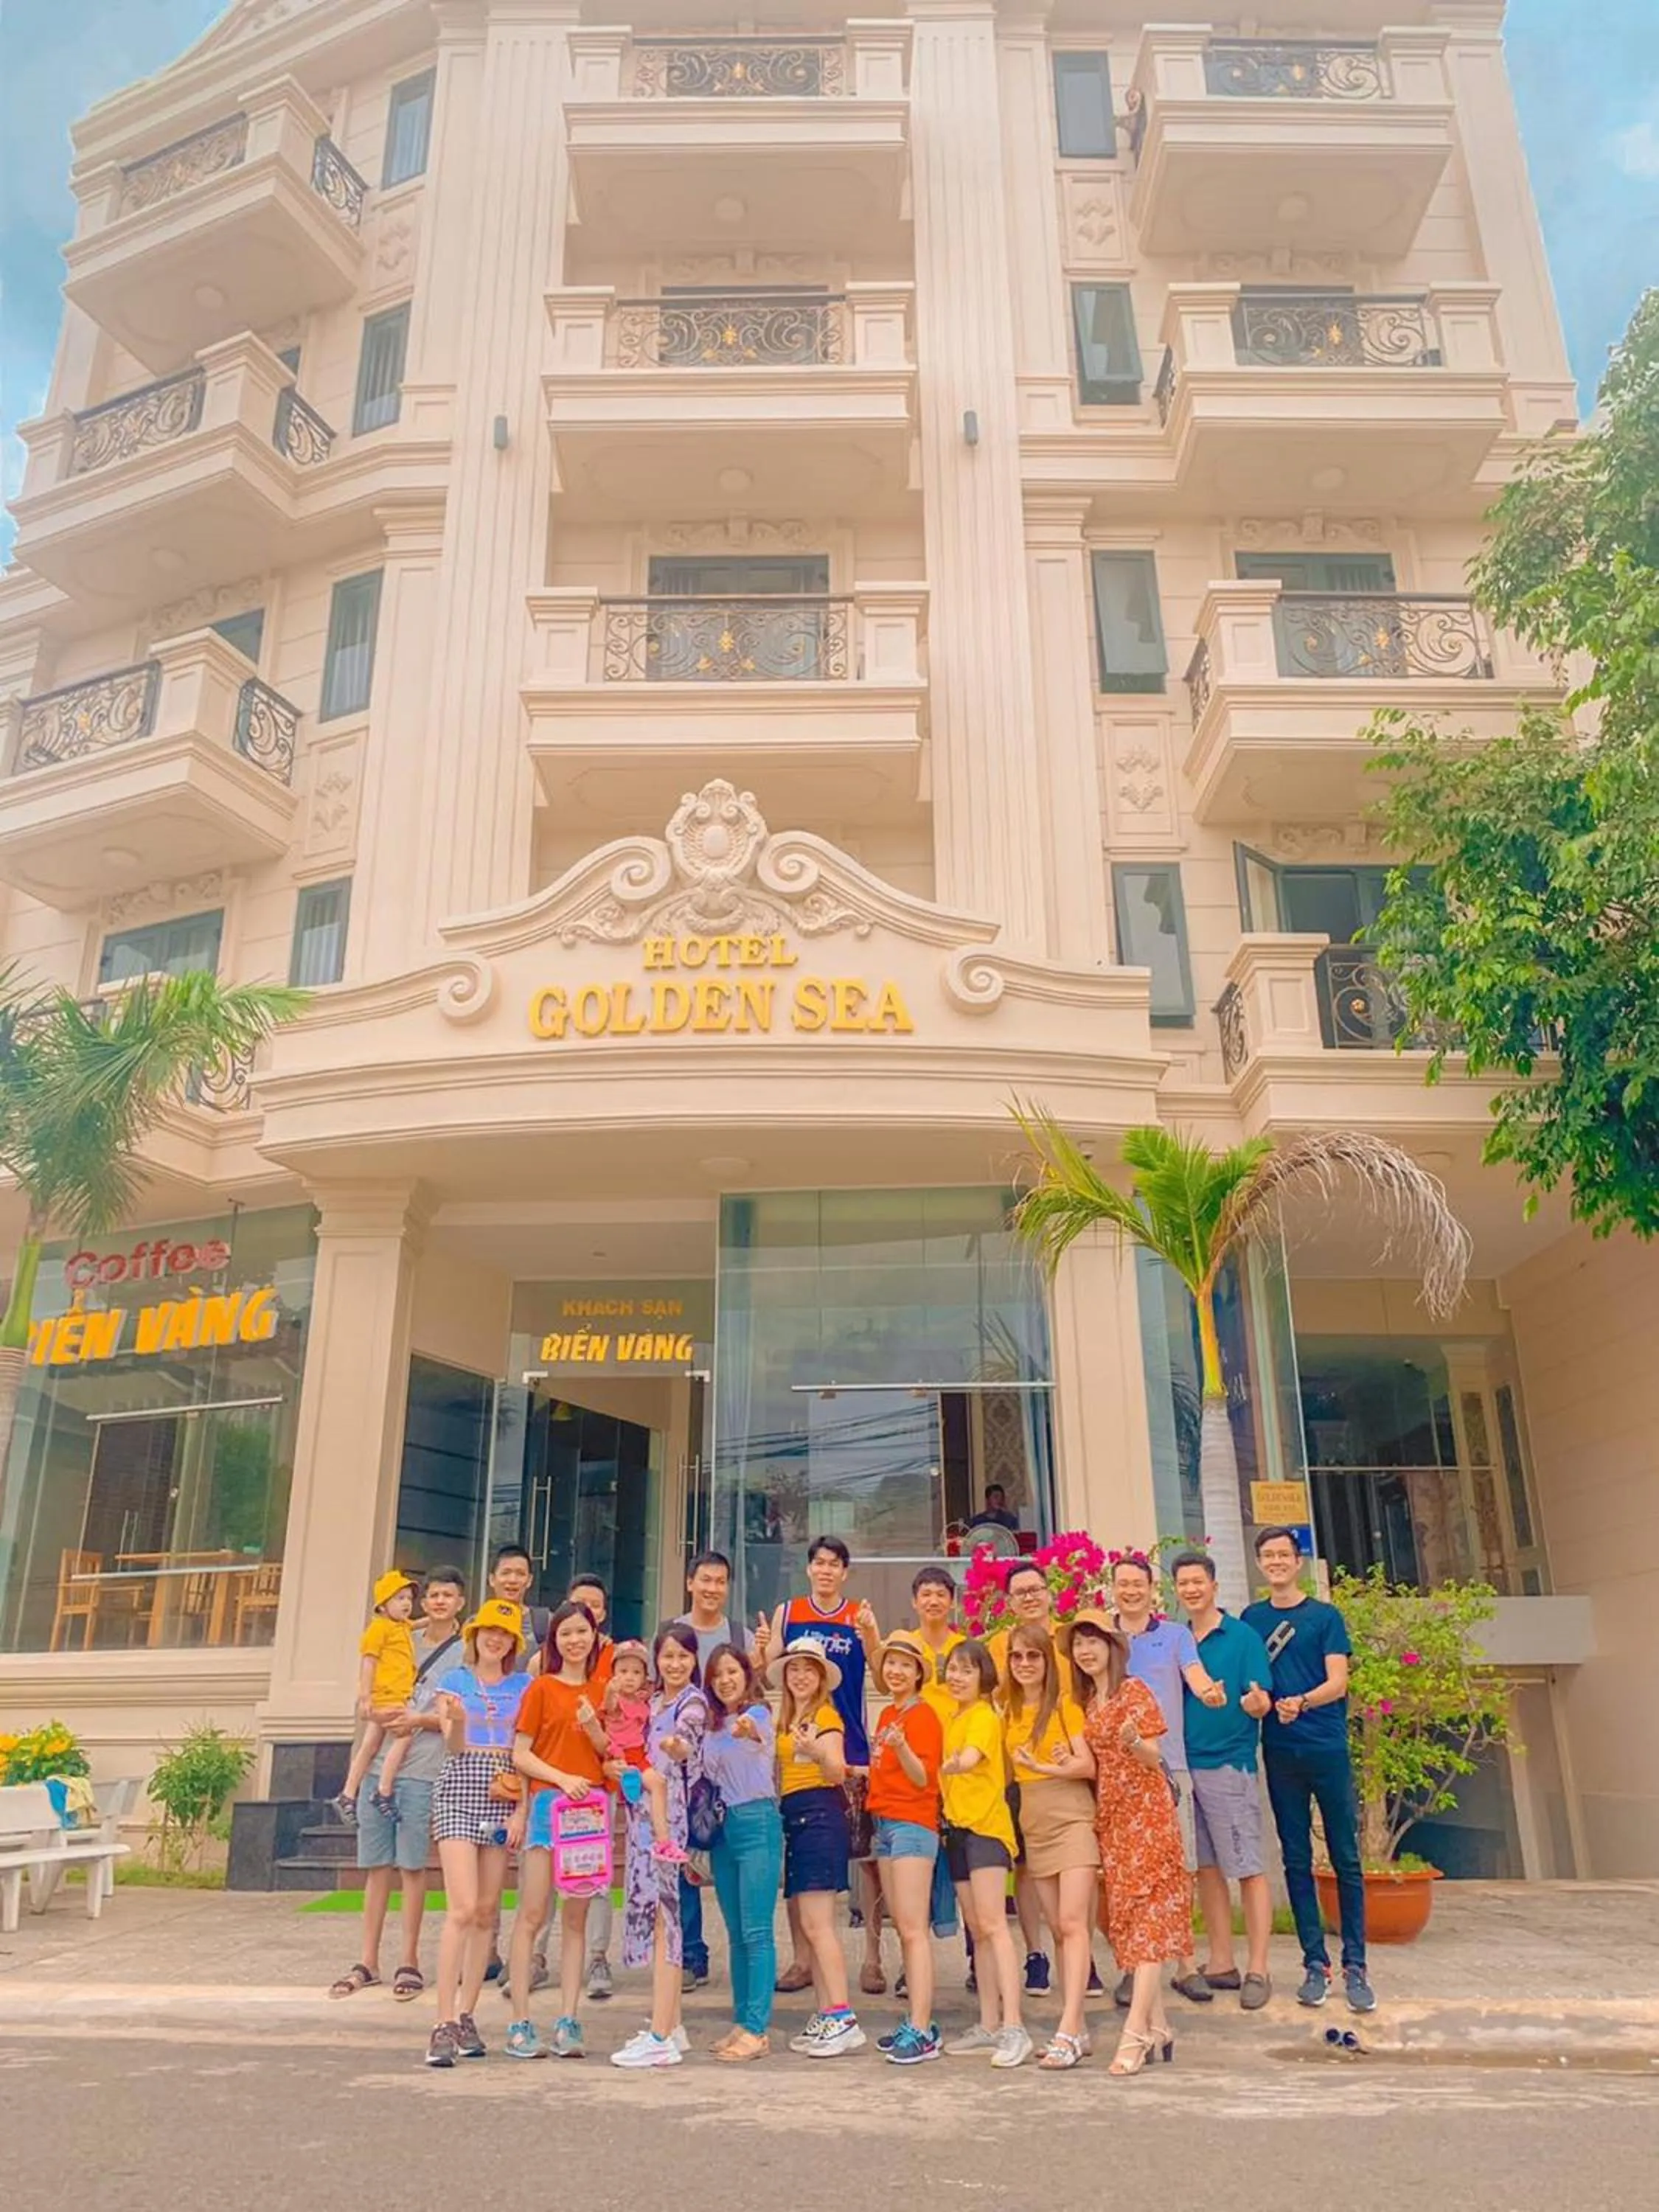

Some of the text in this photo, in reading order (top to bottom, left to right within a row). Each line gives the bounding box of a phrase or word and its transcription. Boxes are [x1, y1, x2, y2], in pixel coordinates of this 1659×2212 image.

[644, 935, 798, 970] HOTEL
[529, 979, 914, 1039] GOLDEN SEA
[66, 1240, 229, 1288] Coffee
[29, 1286, 279, 1366] IỂN VÀNG
[540, 1324, 610, 1361] BIỂN
